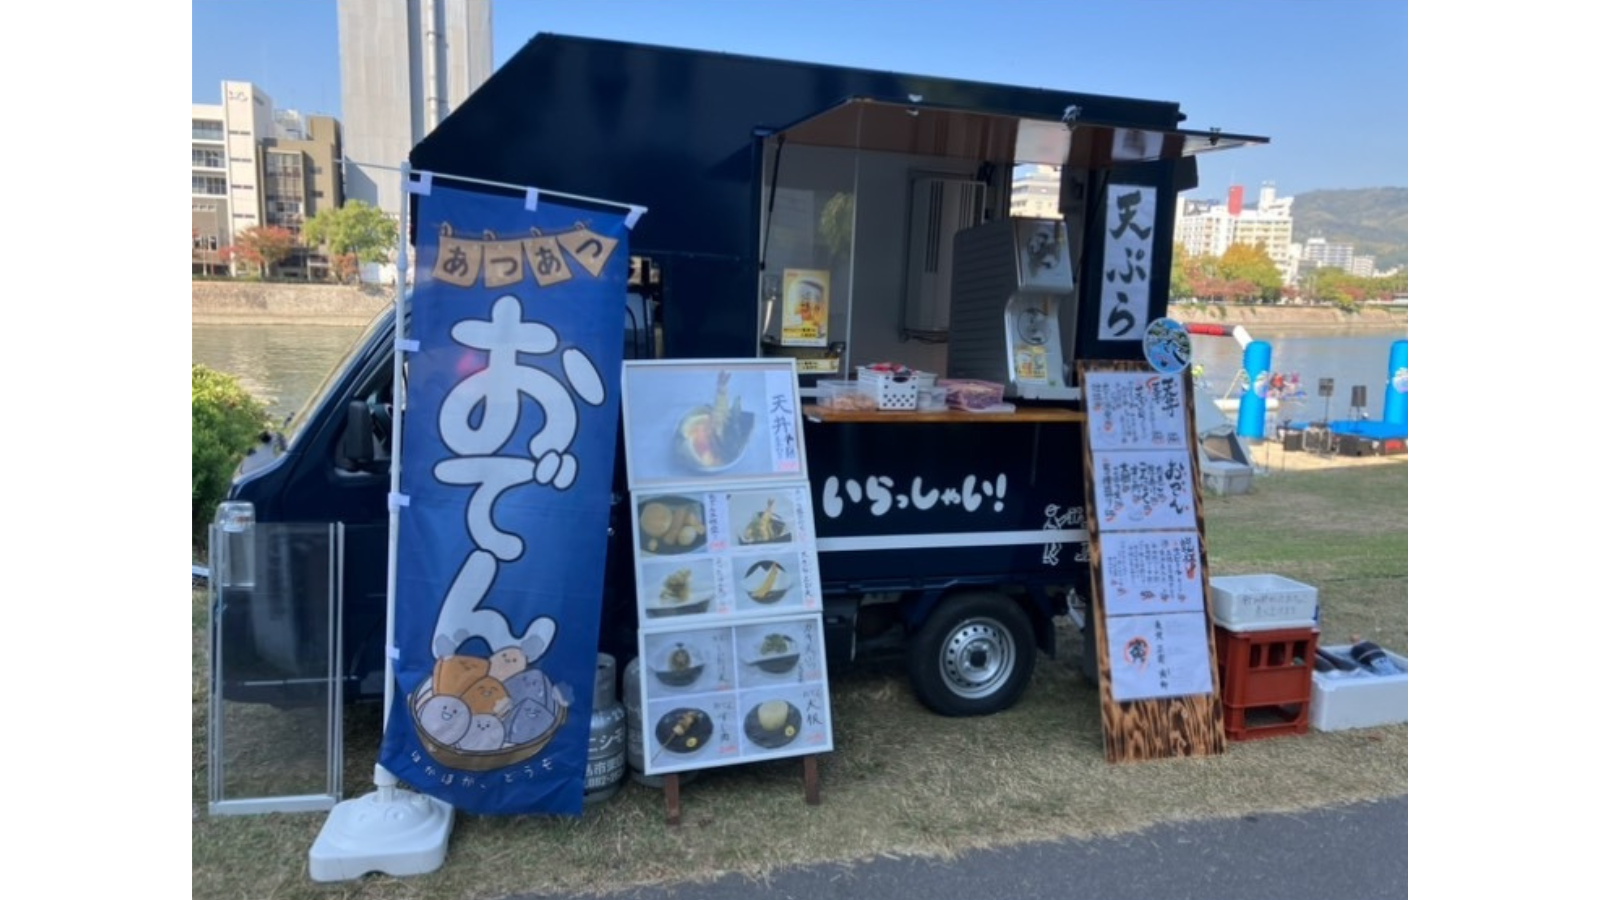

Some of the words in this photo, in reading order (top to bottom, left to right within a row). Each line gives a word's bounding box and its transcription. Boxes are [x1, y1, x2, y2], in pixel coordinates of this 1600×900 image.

[442, 237, 605, 278] あつあつ
[1106, 190, 1152, 337] 天ぷら
[432, 294, 606, 662] おでん
[822, 473, 1008, 518] いらっしゃい!
[1164, 459, 1184, 515] おでん
[805, 699, 824, 727] 大根
